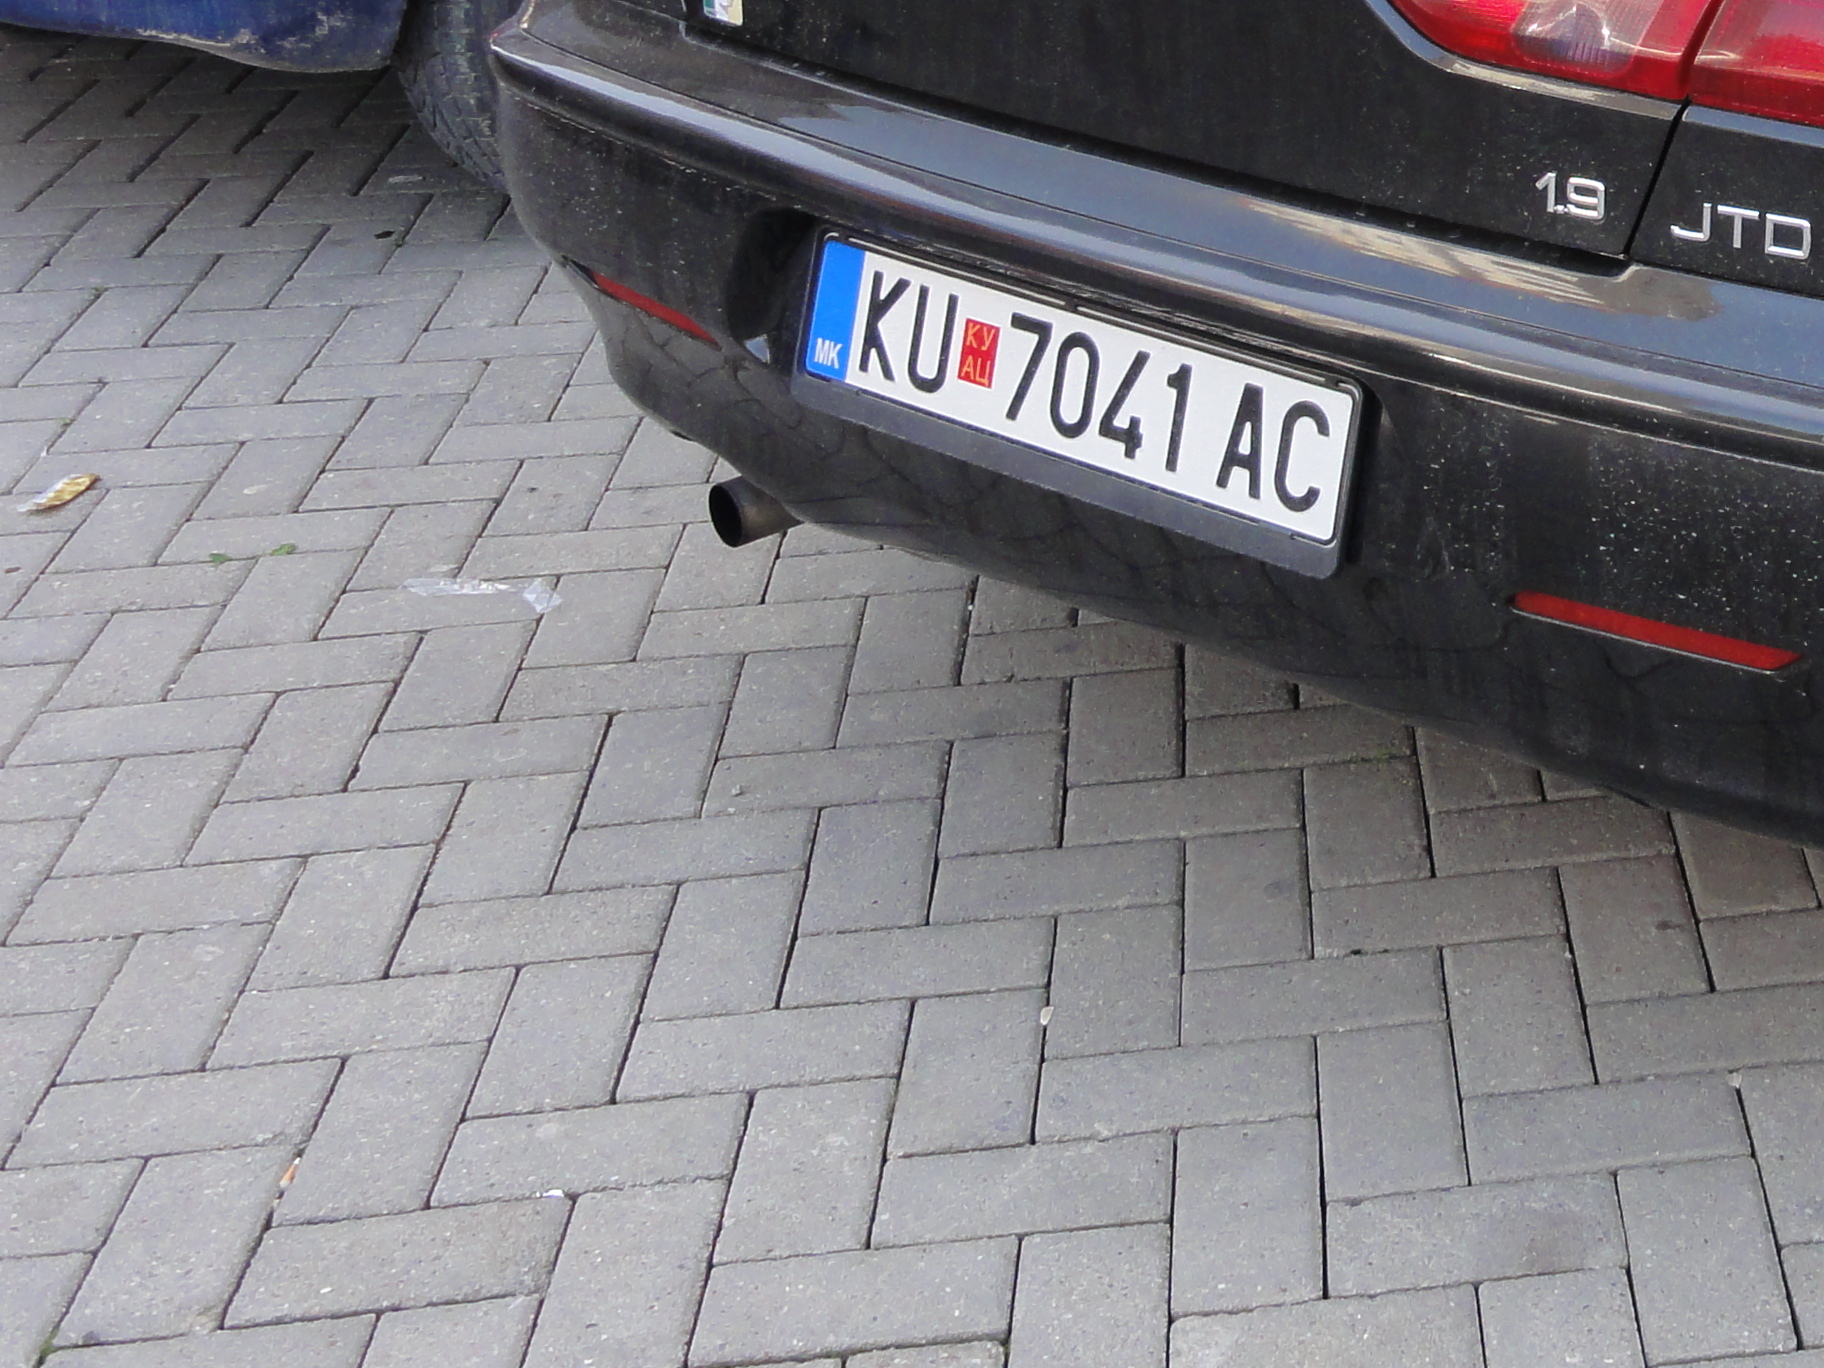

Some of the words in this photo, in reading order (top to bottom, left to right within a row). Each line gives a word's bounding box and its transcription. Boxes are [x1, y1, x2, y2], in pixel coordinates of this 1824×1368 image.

[1535, 171, 1606, 220] 1.9
[1669, 203, 1812, 260] JTD
[814, 337, 842, 370] MK
[858, 270, 959, 394] KU
[1006, 311, 1193, 473] 7041
[1216, 381, 1331, 513] AC
